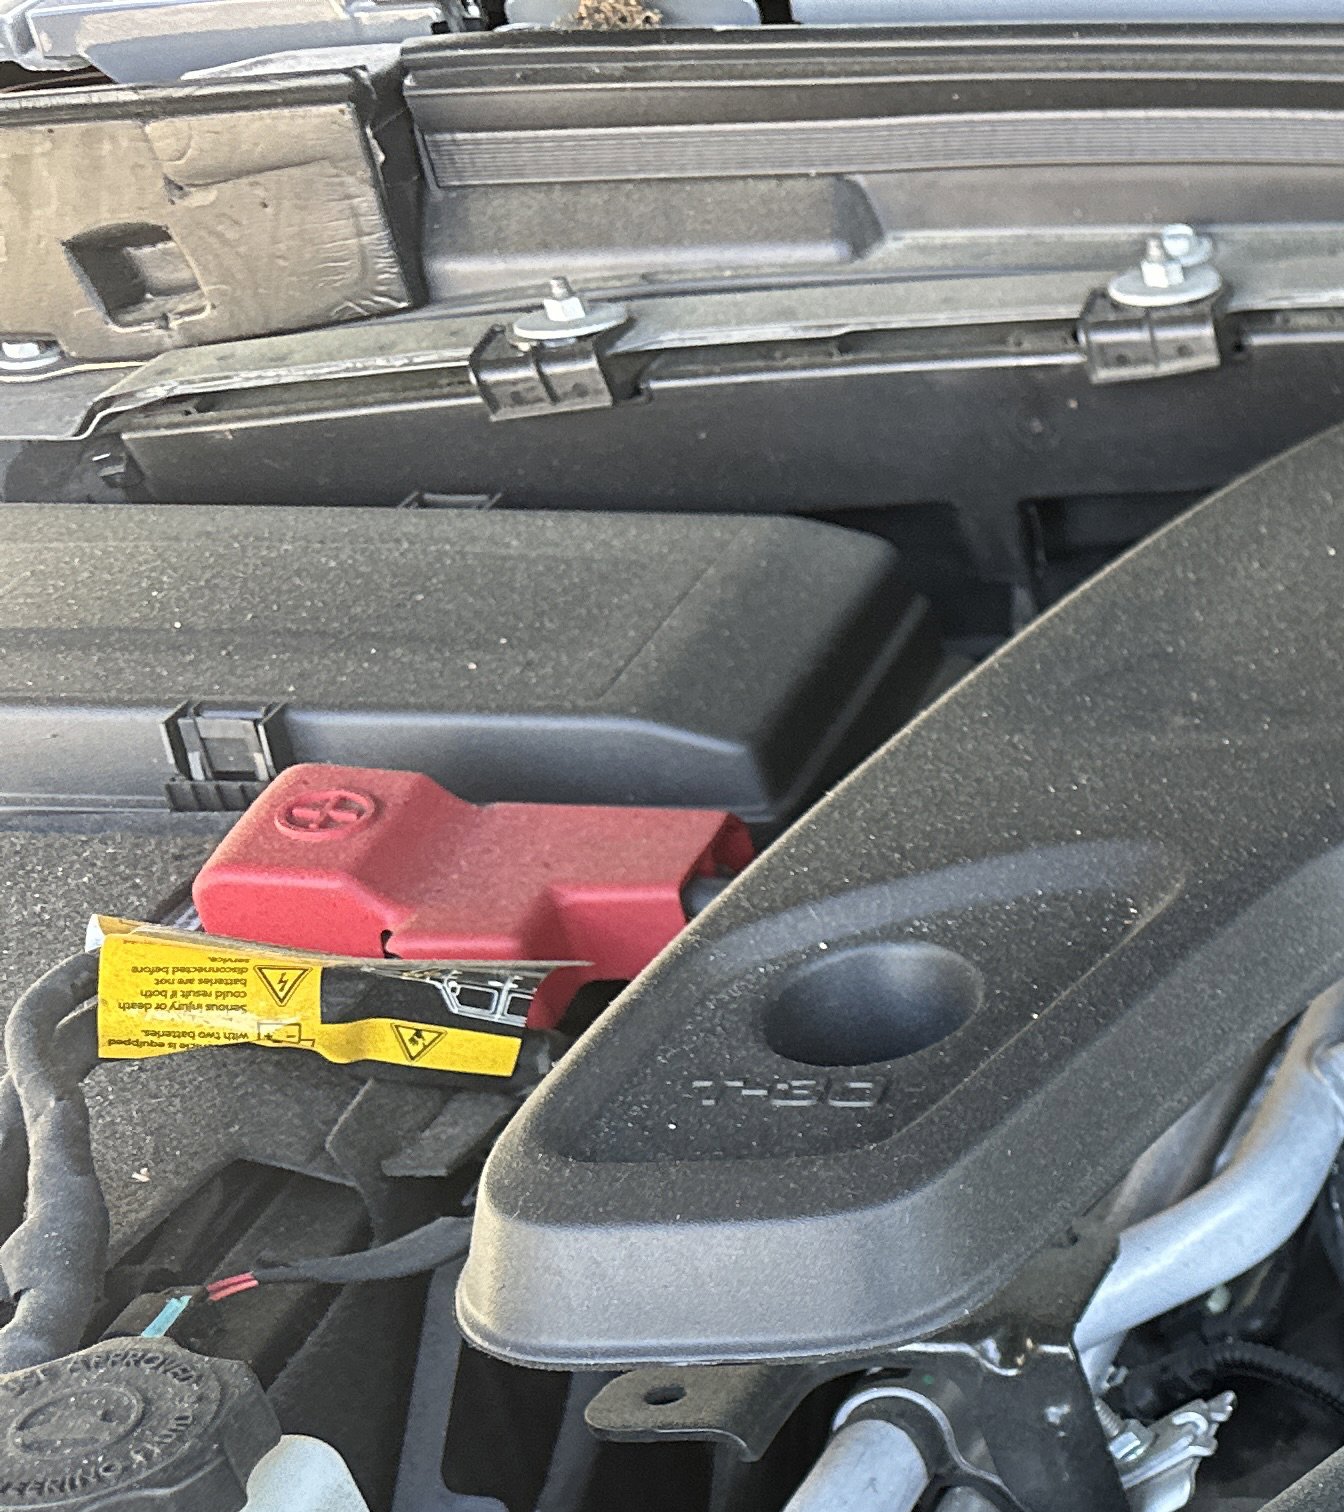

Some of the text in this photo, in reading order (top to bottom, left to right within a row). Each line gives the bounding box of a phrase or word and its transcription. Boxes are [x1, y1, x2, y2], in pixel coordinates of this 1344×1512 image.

[131, 966, 249, 975] disconnected before
[198, 978, 248, 987] batteries
[140, 989, 248, 1000] could result if both
[118, 1001, 248, 1013] Serious injury or death
[141, 1029, 249, 1041] with two batteries.
[107, 1038, 166, 1048] equipped
[68, 1348, 203, 1386] APPROVED
